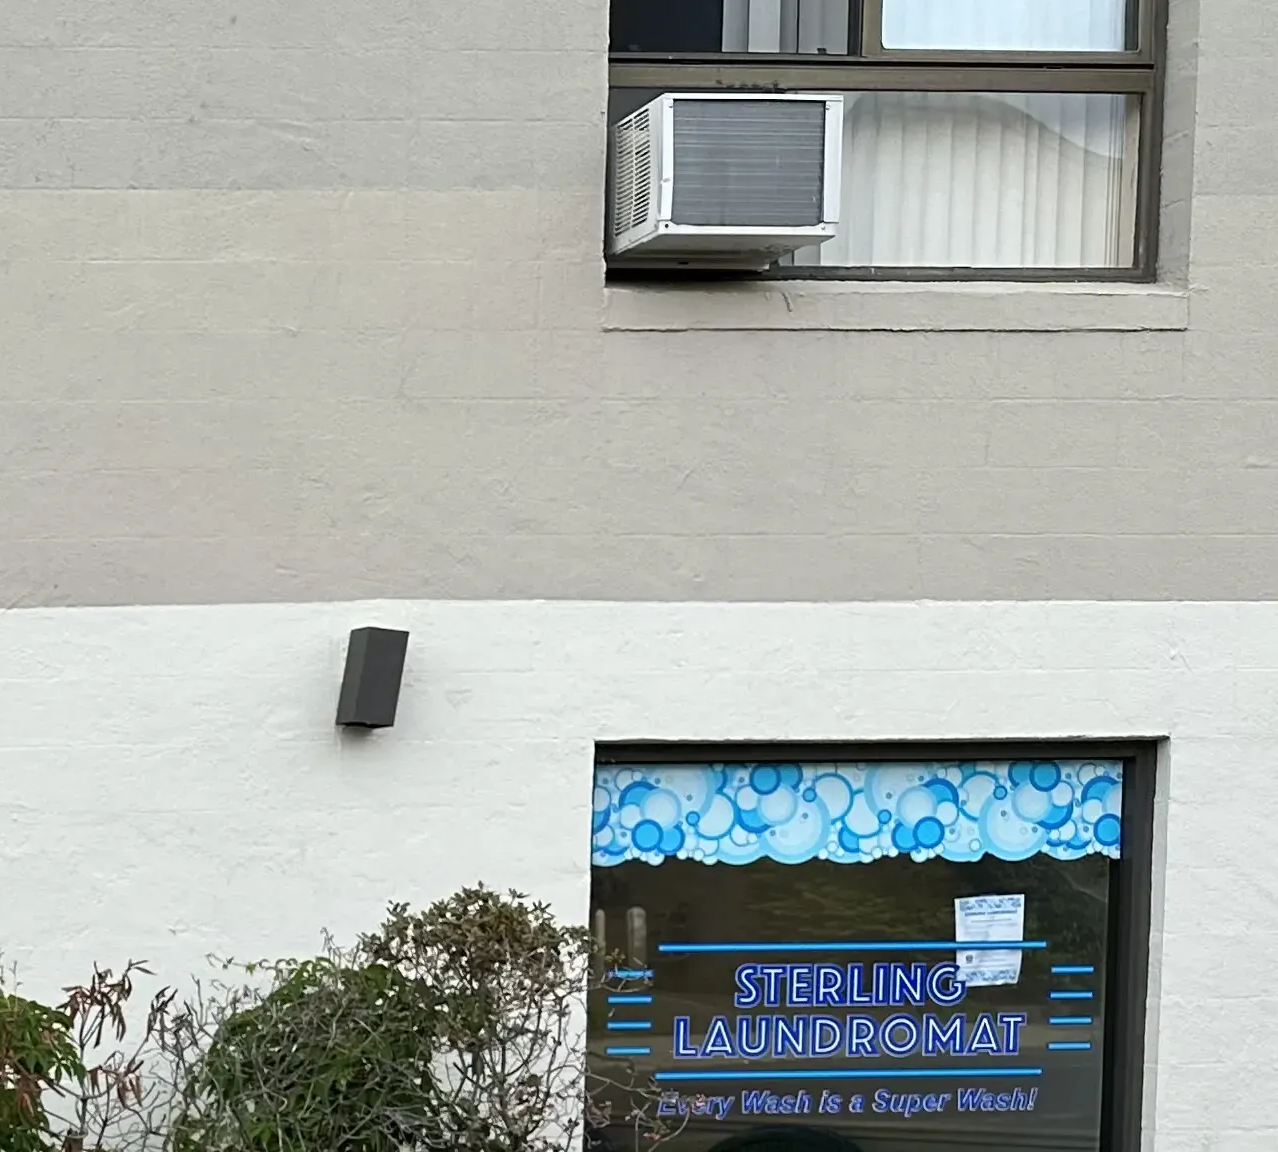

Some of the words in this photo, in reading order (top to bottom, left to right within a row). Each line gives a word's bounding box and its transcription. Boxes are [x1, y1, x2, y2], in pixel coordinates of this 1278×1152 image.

[734, 962, 967, 1008] STERLING
[673, 1012, 1027, 1059] LAUNDROMAT
[741, 1089, 813, 1114] Wash
[818, 1089, 843, 1114] is
[848, 1093, 865, 1113] a
[871, 1088, 951, 1118] Super
[957, 1087, 1039, 1112] Wash!
